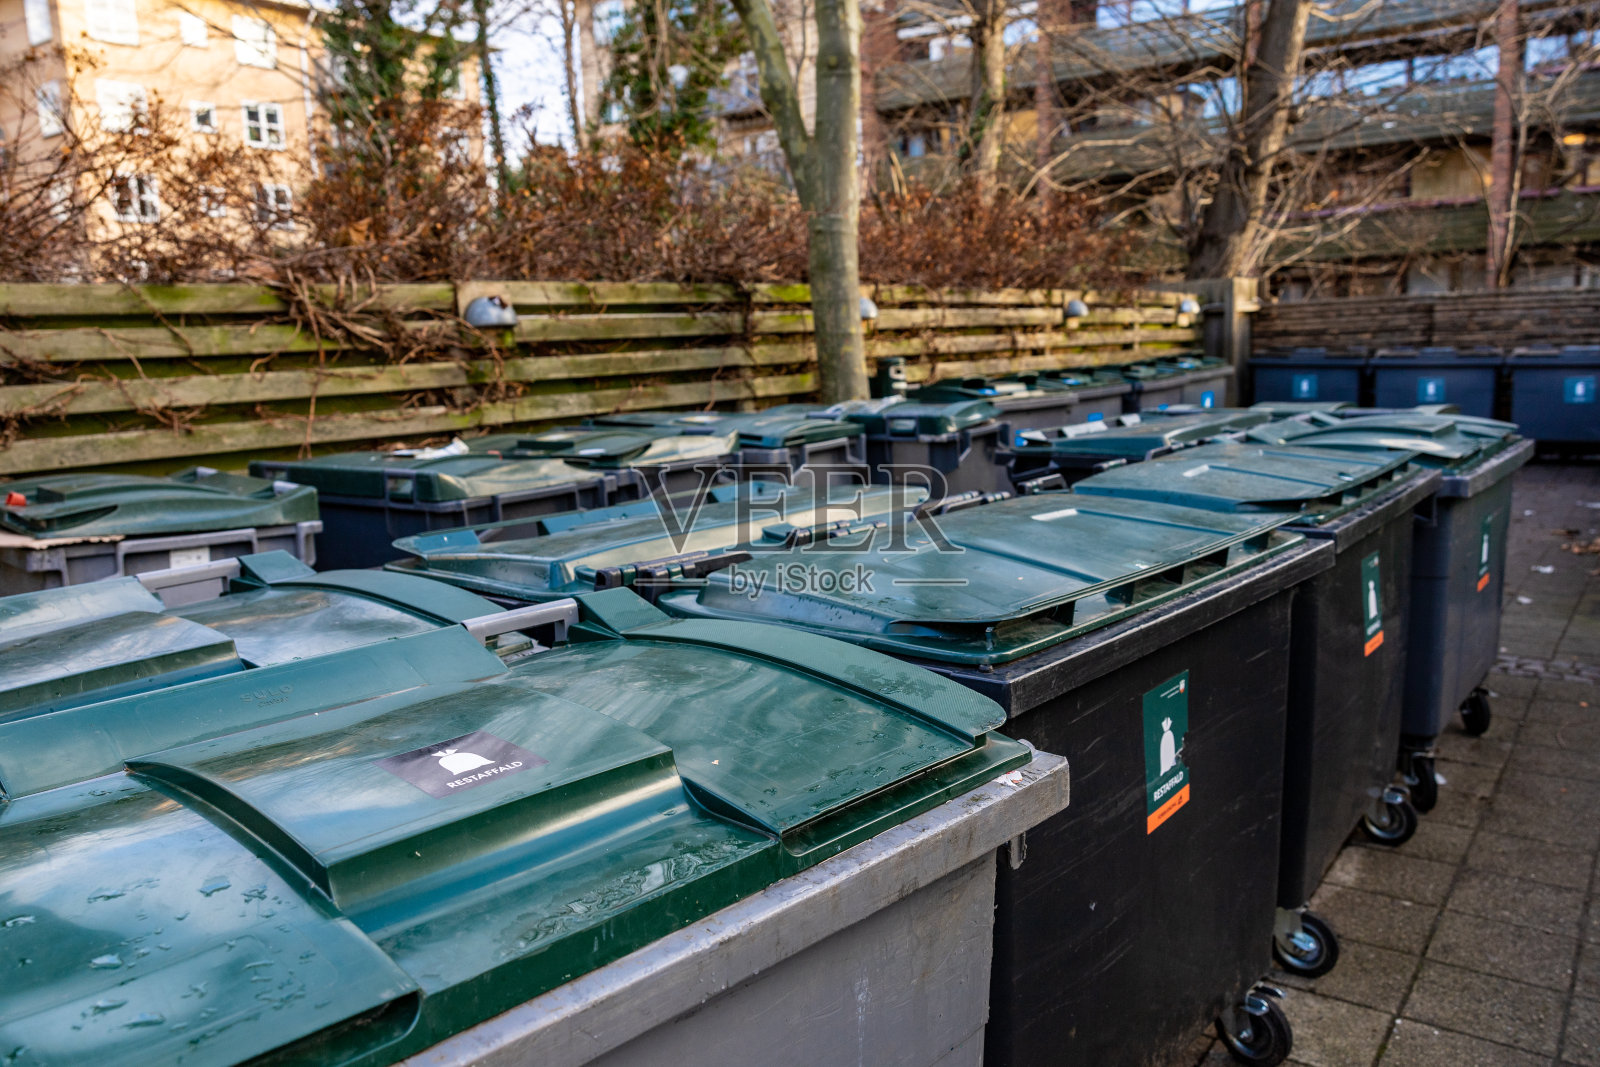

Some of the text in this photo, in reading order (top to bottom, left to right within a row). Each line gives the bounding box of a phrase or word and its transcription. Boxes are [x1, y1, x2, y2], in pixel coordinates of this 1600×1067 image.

[240, 684, 293, 703] SULO
[446, 761, 523, 789] RESTAFFALD
[1153, 771, 1184, 802] RESTAFFALD
